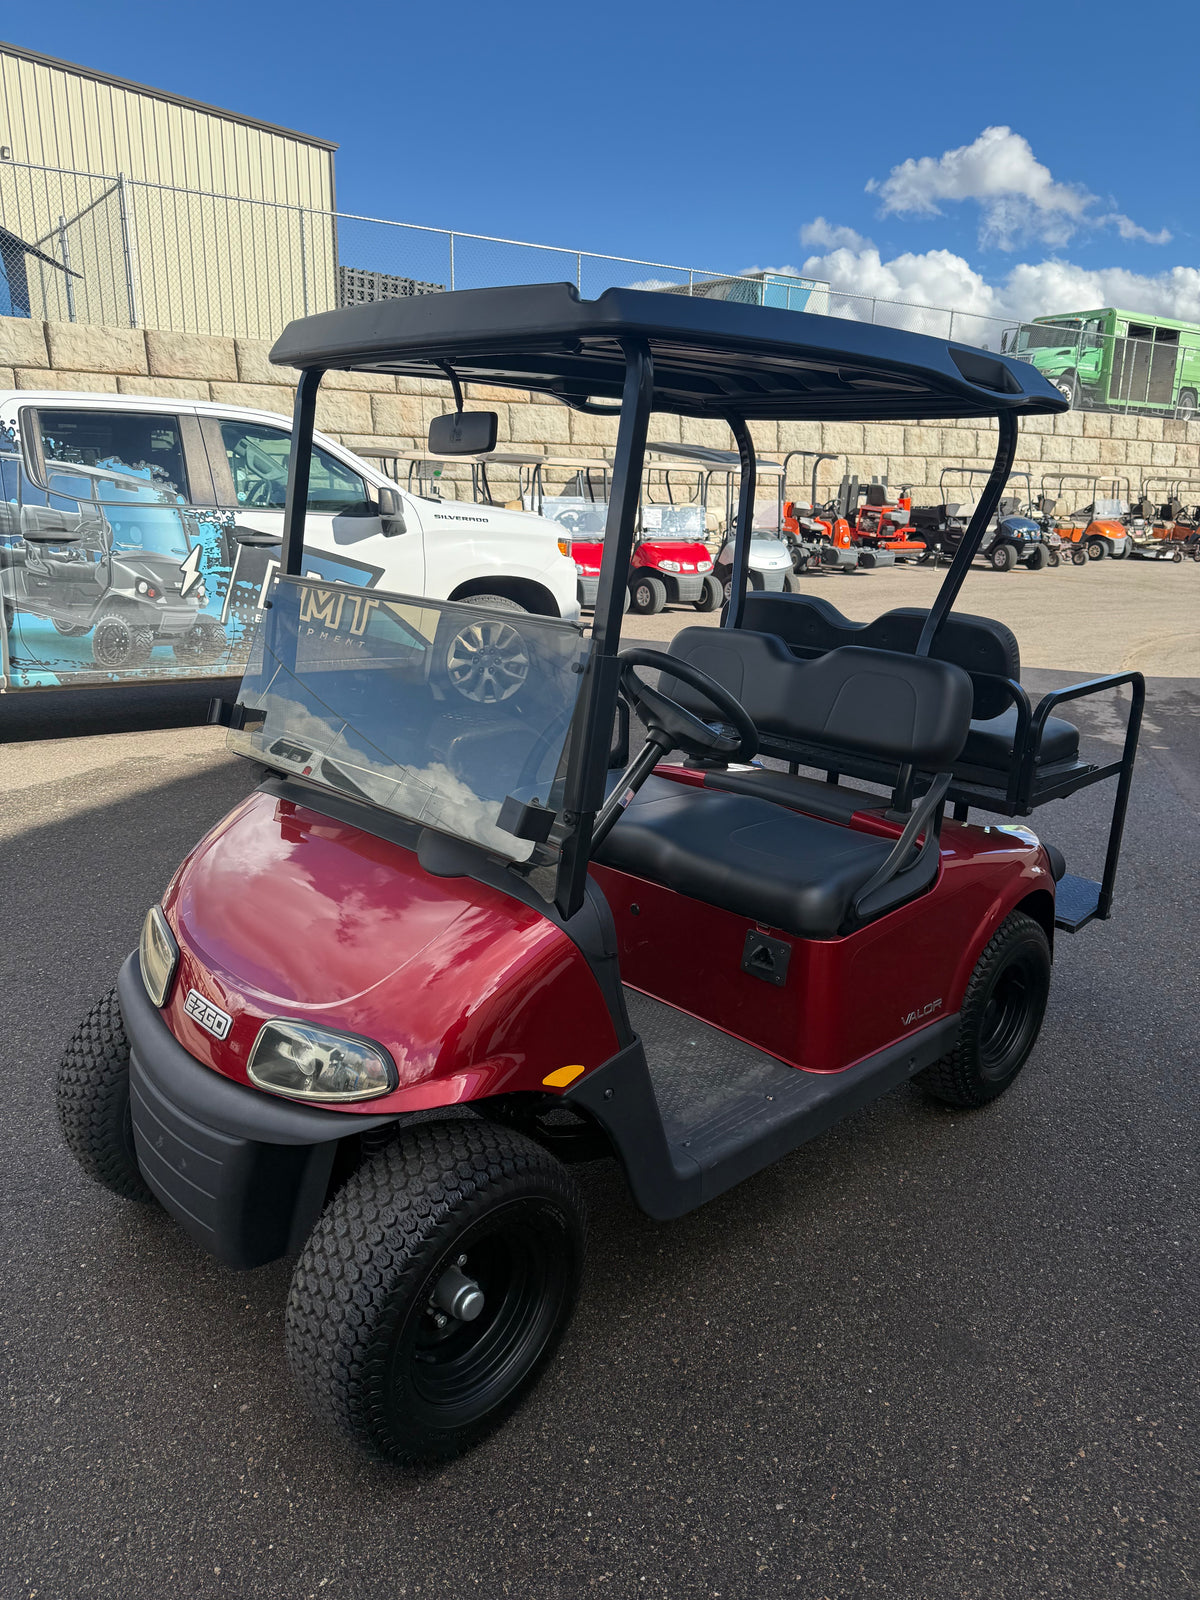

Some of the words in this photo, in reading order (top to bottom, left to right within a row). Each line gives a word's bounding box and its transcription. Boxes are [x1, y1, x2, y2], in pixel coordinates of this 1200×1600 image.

[433, 514, 489, 523] SILVERADO
[254, 613, 366, 648] EIPMENT
[185, 991, 229, 1037] EZGO
[901, 998, 943, 1026] VALOR
